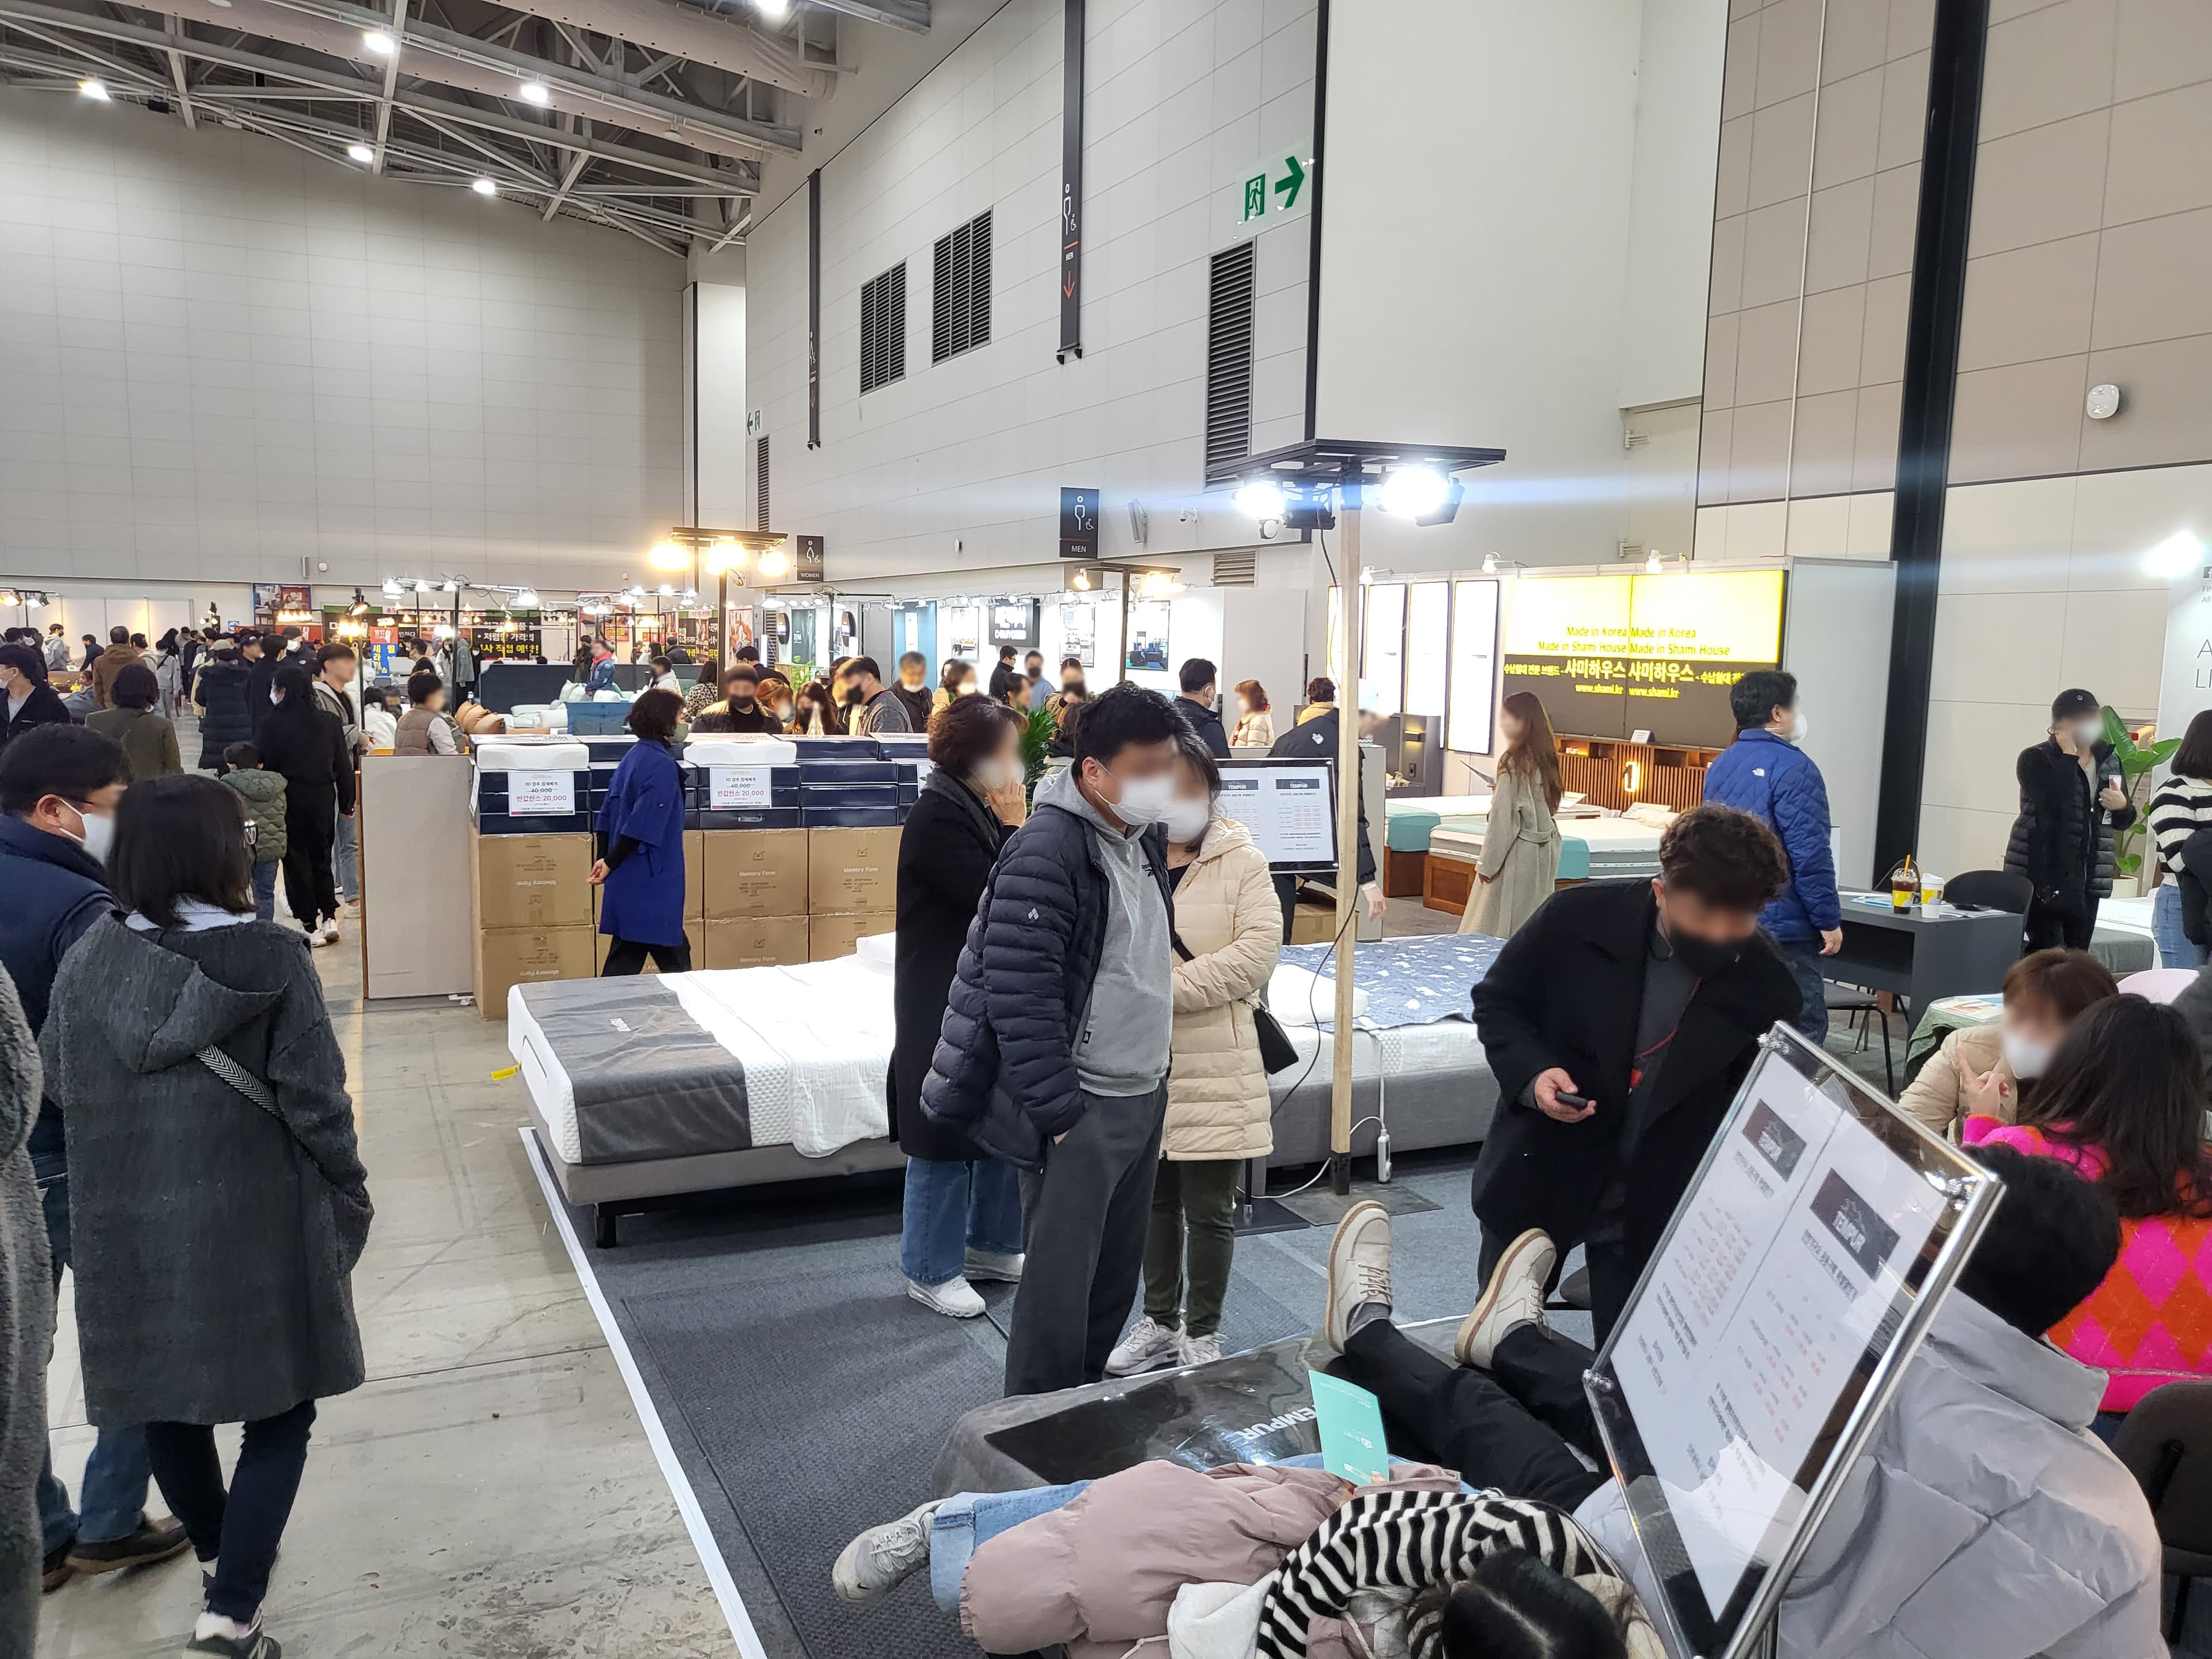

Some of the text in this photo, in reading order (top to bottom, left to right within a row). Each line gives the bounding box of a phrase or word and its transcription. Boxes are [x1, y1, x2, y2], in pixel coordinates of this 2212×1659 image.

[1567, 627, 1627, 637] Made in Korea
[1631, 627, 1696, 638] Made in Korea
[1539, 641, 1626, 653] Made in Shami House
[1630, 643, 1730, 656] Made in Shami House
[1565, 658, 1627, 680] 샤미하우스
[1628, 660, 1695, 684] 샤미하우스
[1575, 683, 1624, 695] www.shami.kr
[1628, 687, 1680, 699] www.shami.kr
[1832, 1210, 1866, 1253] TEMPUR
[1234, 1404, 1317, 1441] EMPUR
